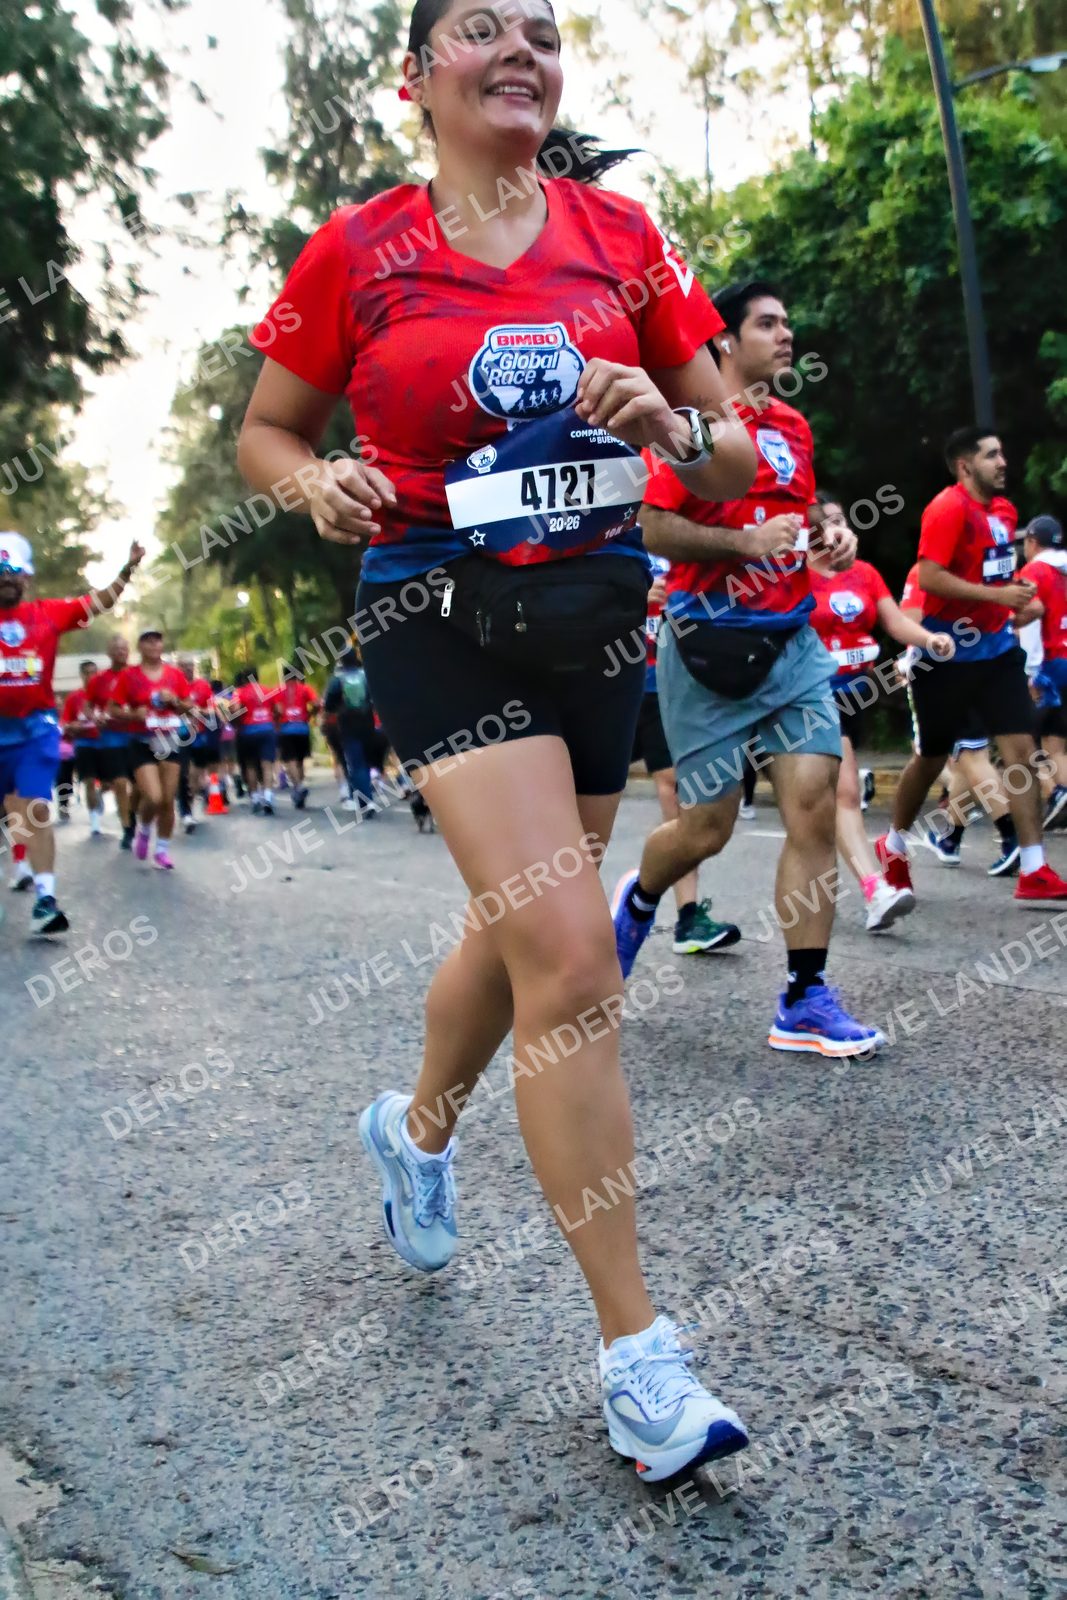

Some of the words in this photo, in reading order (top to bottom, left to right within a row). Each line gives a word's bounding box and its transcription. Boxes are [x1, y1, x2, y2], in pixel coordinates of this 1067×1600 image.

[496, 333, 559, 347] BIMBO
[499, 352, 559, 370] Global
[488, 368, 537, 386] Race
[570, 428, 610, 438] COMPART
[520, 463, 596, 511] 4727
[549, 515, 580, 533] 20-26
[846, 650, 865, 664] 1515
